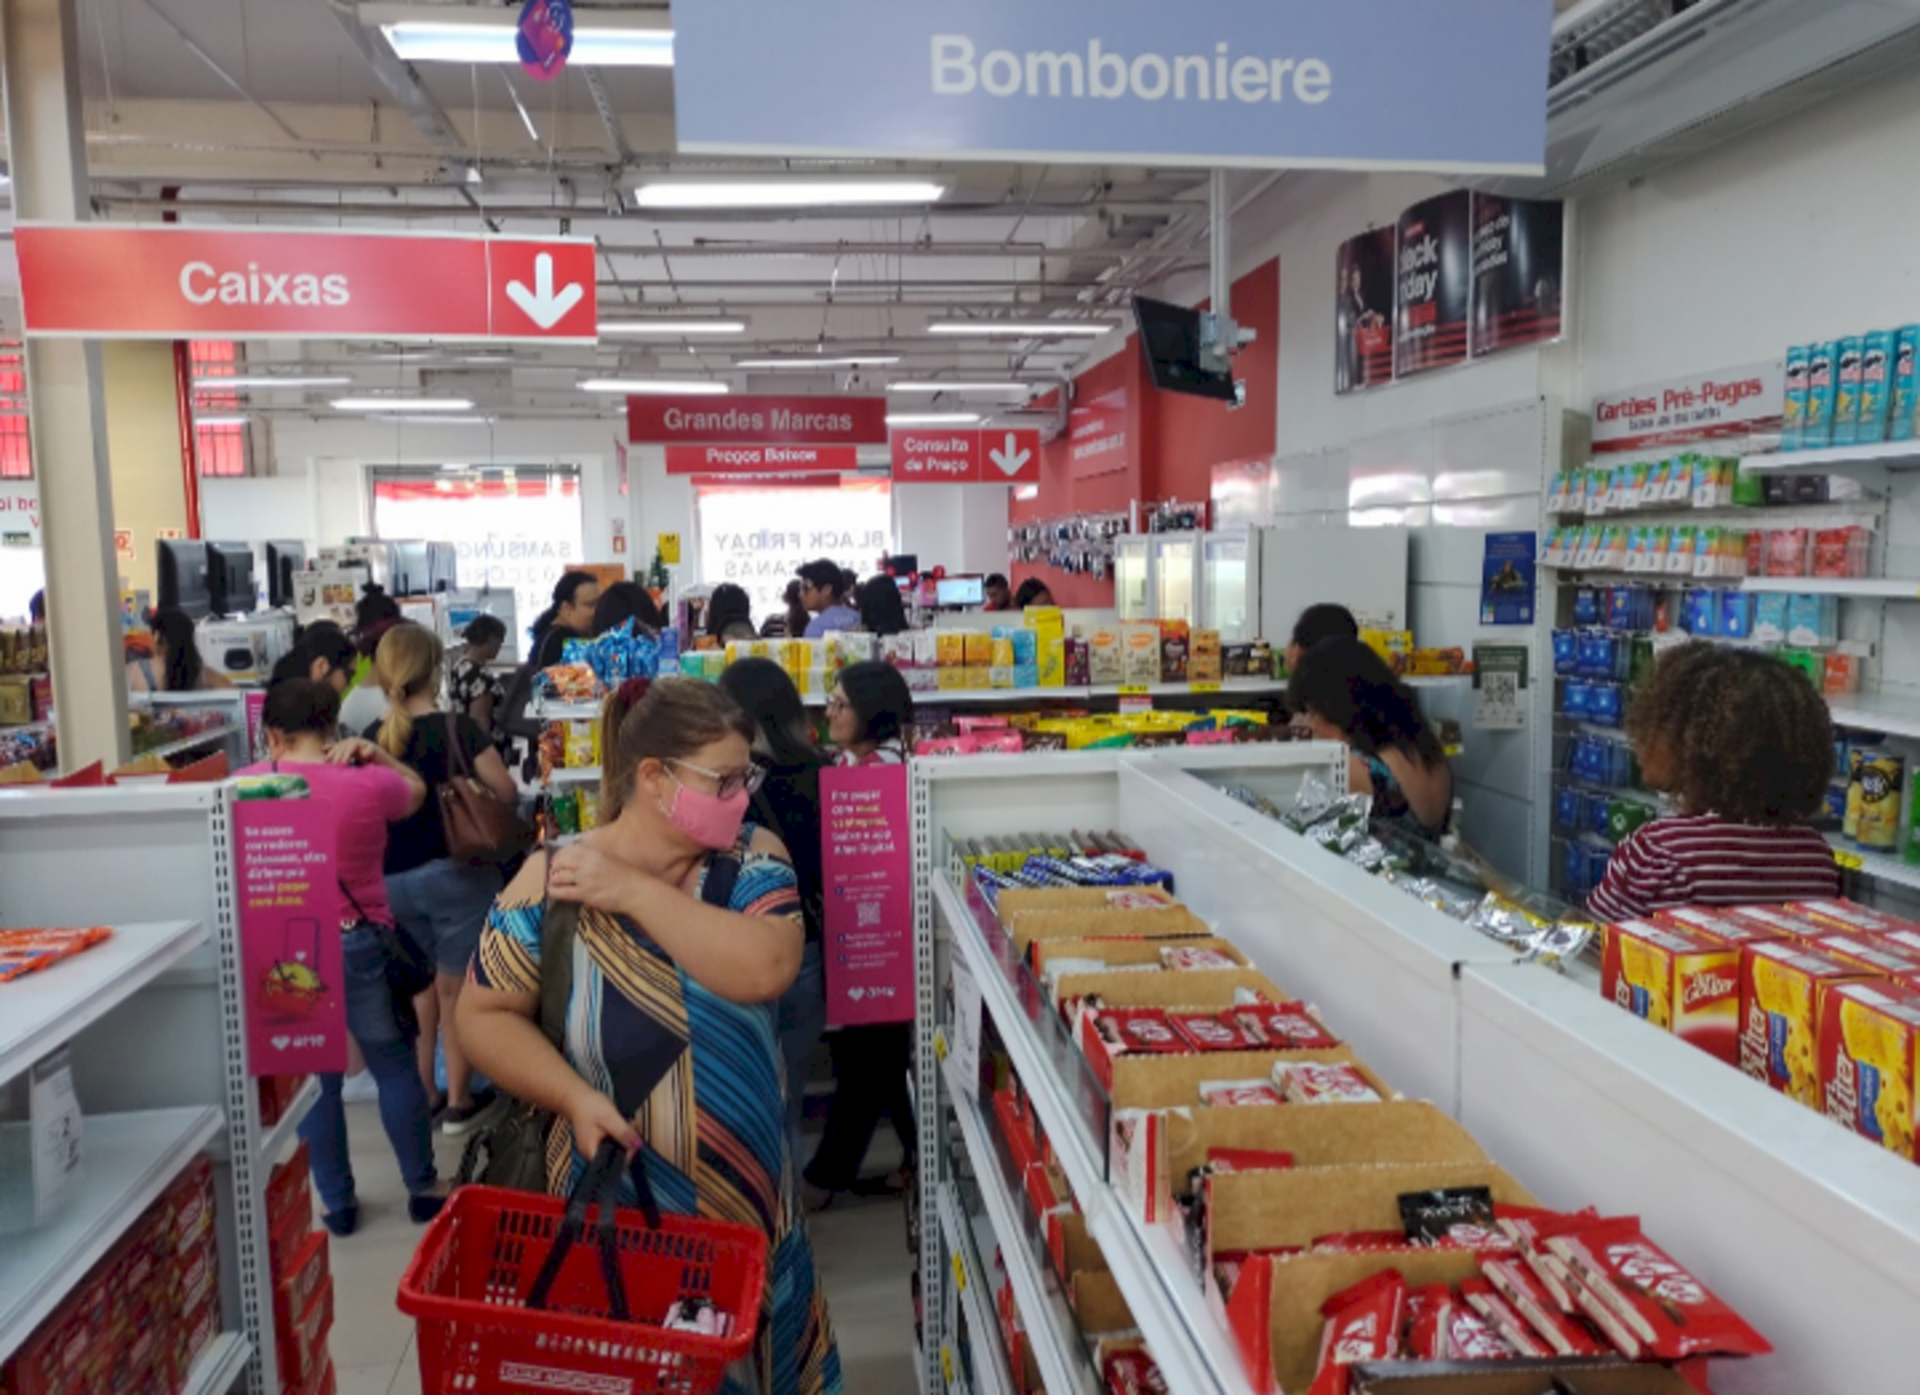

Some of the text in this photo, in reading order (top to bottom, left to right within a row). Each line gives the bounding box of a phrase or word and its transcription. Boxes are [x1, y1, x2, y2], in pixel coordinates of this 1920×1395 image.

[930, 34, 1331, 104] Bomboniere
[179, 260, 350, 305] Caixas
[664, 408, 853, 431] Grandes Marcas
[904, 437, 968, 453] Consulta
[706, 447, 817, 465] Preços Baixos
[904, 456, 968, 475] de Preço
